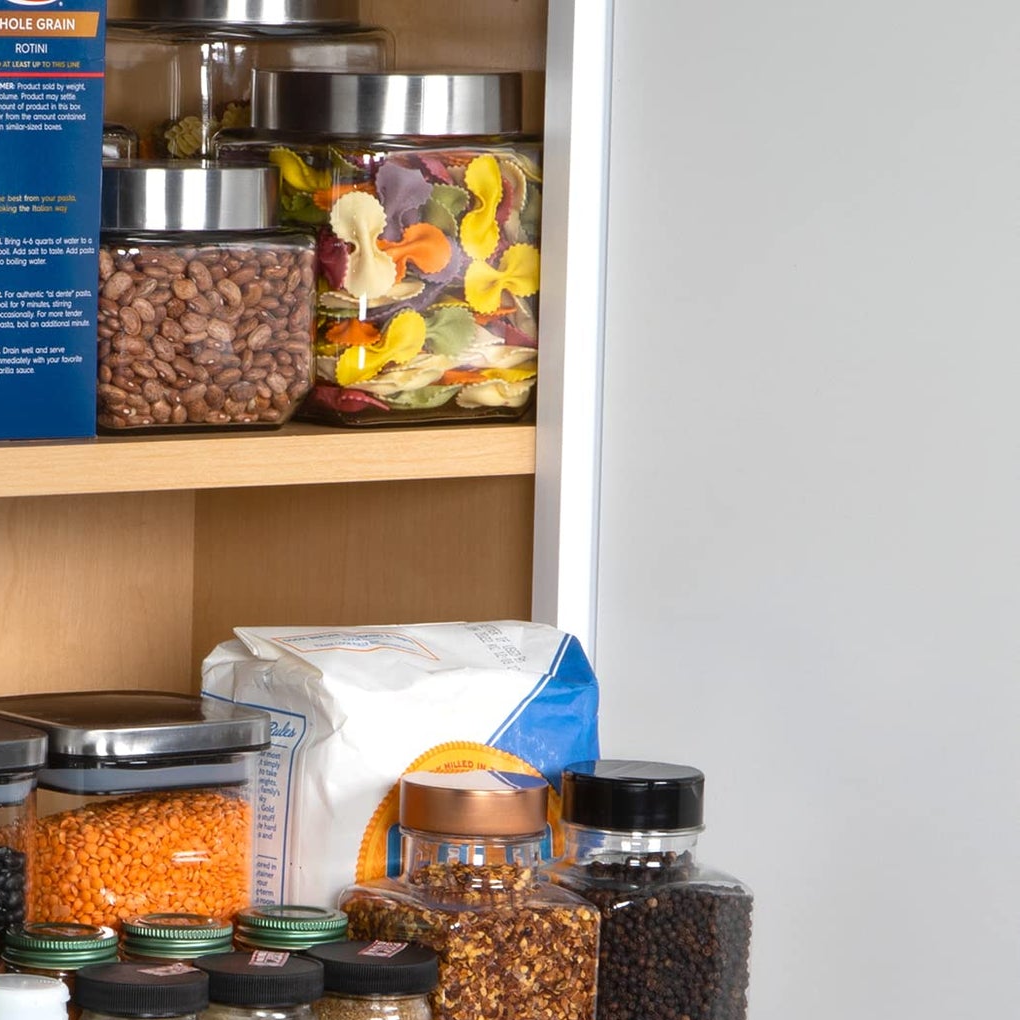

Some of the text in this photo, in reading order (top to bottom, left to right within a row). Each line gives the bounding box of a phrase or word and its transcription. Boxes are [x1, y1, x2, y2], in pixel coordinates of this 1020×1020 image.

[36, 18, 76, 30] GRAIN
[15, 42, 48, 54] ROTINI
[2, 61, 10, 69] AT
[12, 61, 30, 69] LEAST
[32, 61, 40, 69] UP
[42, 61, 50, 69] TO
[52, 61, 66, 69] THIS
[67, 61, 80, 69] LINE
[17, 82, 41, 91] Product
[42, 82, 55, 91] sold
[56, 82, 64, 92] by
[445, 760, 474, 769] MILLED
